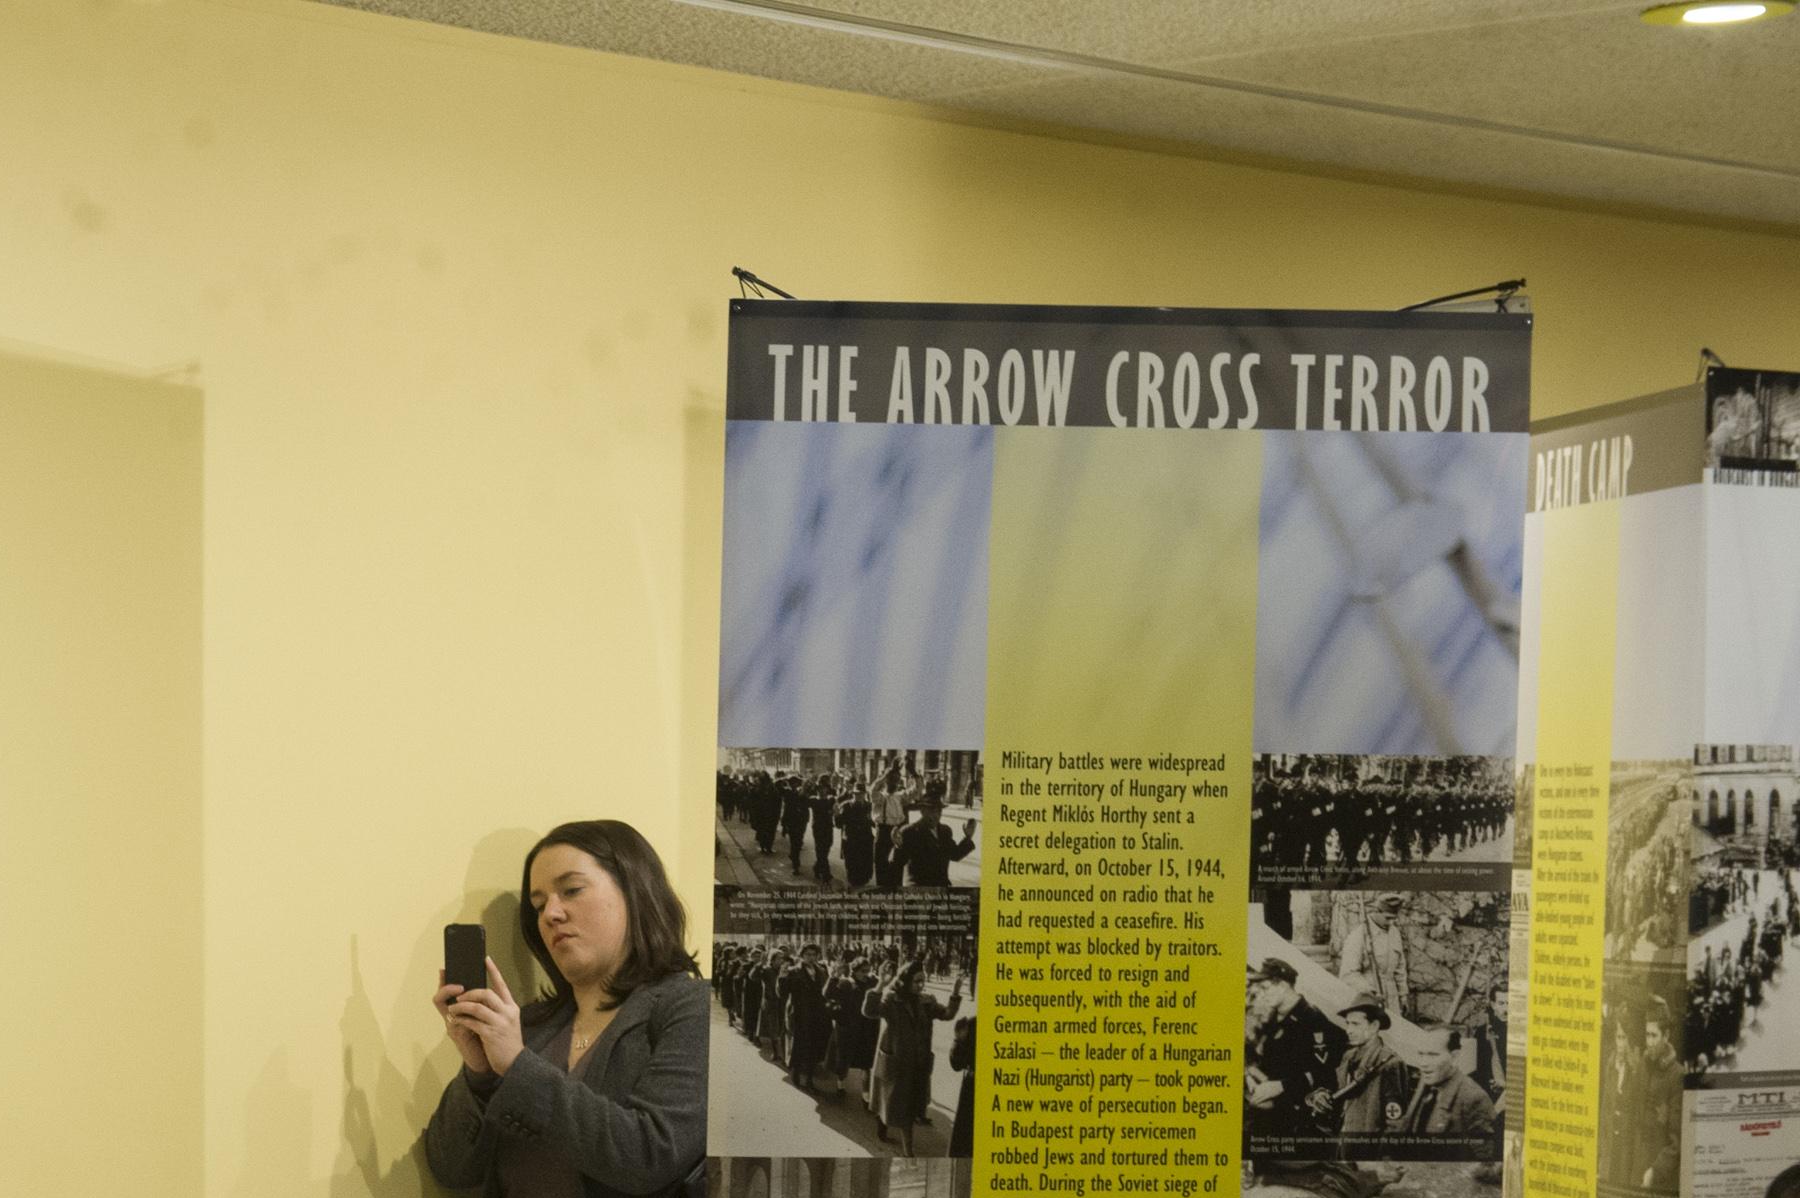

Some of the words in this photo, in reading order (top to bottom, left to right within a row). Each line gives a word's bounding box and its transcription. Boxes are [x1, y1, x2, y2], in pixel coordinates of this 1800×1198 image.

[769, 344, 858, 423] THE
[888, 346, 1075, 426] ARROW
[1106, 350, 1260, 430] CROSS
[1291, 353, 1490, 432] TERROR
[1535, 444, 1583, 512] DEATH
[1588, 435, 1634, 505] CAMP
[1002, 751, 1053, 775] Military
[1059, 752, 1104, 770] battles
[1110, 758, 1142, 770] were
[1148, 753, 1225, 776] widespread
[1001, 778, 1013, 795] in
[1020, 778, 1041, 795] the
[1048, 778, 1104, 802] territory
[1110, 779, 1124, 797] of
[1130, 779, 1186, 803] Hungary
[1193, 780, 1228, 797] when
[1001, 804, 1047, 828] Regent
[1053, 805, 1094, 823] Miklós
[1101, 805, 1147, 829] Horthy
[1153, 810, 1181, 823] sent
[1187, 811, 1194, 824] a
[1000, 835, 1039, 848] secret
[1045, 831, 1115, 855] delegation
[1122, 836, 1135, 850] to
[1142, 832, 1183, 850] Stalin.
[998, 857, 1068, 879] Afterward,
[1075, 863, 1091, 875] on
[1098, 858, 1152, 876] October
[1160, 859, 1179, 879] 15,
[1188, 859, 1224, 879] 1944,
[998, 884, 1013, 901] he
[1020, 885, 1094, 902] announced
[1100, 890, 1116, 902] on
[1123, 885, 1158, 902] radio
[1165, 885, 1192, 903] that
[1198, 886, 1214, 903] he
[998, 910, 1022, 928] had
[1029, 911, 1094, 933] requested
[1101, 916, 1108, 928] a
[1115, 912, 1177, 929] ceasefire.
[1184, 912, 1204, 929] His
[997, 940, 1050, 960] attempt
[1056, 942, 1081, 954] was
[1088, 937, 1139, 955] blocked
[1146, 938, 1162, 961] by
[1168, 938, 1222, 956] traitors.
[996, 963, 1013, 980] He
[1019, 968, 1044, 980] was
[1050, 963, 1092, 981] forced
[1099, 968, 1112, 981] to
[1118, 964, 1158, 987] resign
[1165, 964, 1189, 982] and
[995, 989, 1087, 1013] subsequently,
[1093, 990, 1122, 1008] with
[1129, 991, 1150, 1008] the
[1156, 991, 1176, 1008] aid
[1183, 991, 1196, 1008] of
[994, 1015, 1047, 1033] German
[1054, 1016, 1096, 1034] armed
[1103, 1016, 1146, 1038] forces,
[1153, 1017, 1197, 1035] Ferenc
[994, 1041, 1036, 1059] Szálasi
[1060, 1043, 1080, 1060] the
[1086, 1043, 1127, 1060] leader
[1132, 1043, 1145, 1060] of
[1149, 1048, 1157, 1060] a
[1163, 1043, 1231, 1067] Hungarian
[994, 1068, 1020, 1085] Nazi
[1025, 1068, 1094, 1092] (Hungarist)
[1100, 1073, 1133, 1092] party
[1155, 1070, 1183, 1087] took
[1188, 1075, 1230, 1092] power.
[992, 1094, 1000, 1111] A
[1007, 1100, 1034, 1112] new
[1040, 1100, 1073, 1112] wave
[1079, 1095, 1093, 1112] of
[1098, 1096, 1176, 1118] persecution
[1183, 1096, 1227, 1119] began.
[992, 1120, 1004, 1138] In
[1011, 1120, 1073, 1144] Budapest
[1080, 1125, 1115, 1144] party
[1121, 1122, 1196, 1139] servicemen
[991, 1147, 1038, 1164] robbed
[1043, 1147, 1074, 1169] Jews
[1080, 1148, 1105, 1165] and
[1112, 1148, 1167, 1165] tortured
[1174, 1148, 1208, 1166] them
[1215, 1152, 1228, 1166] to
[990, 1173, 1032, 1191] death.
[1039, 1173, 1085, 1197] During
[1091, 1174, 1112, 1191] the
[1118, 1174, 1158, 1192] Soviet
[1164, 1175, 1197, 1198] siege
[1204, 1175, 1218, 1192] of
